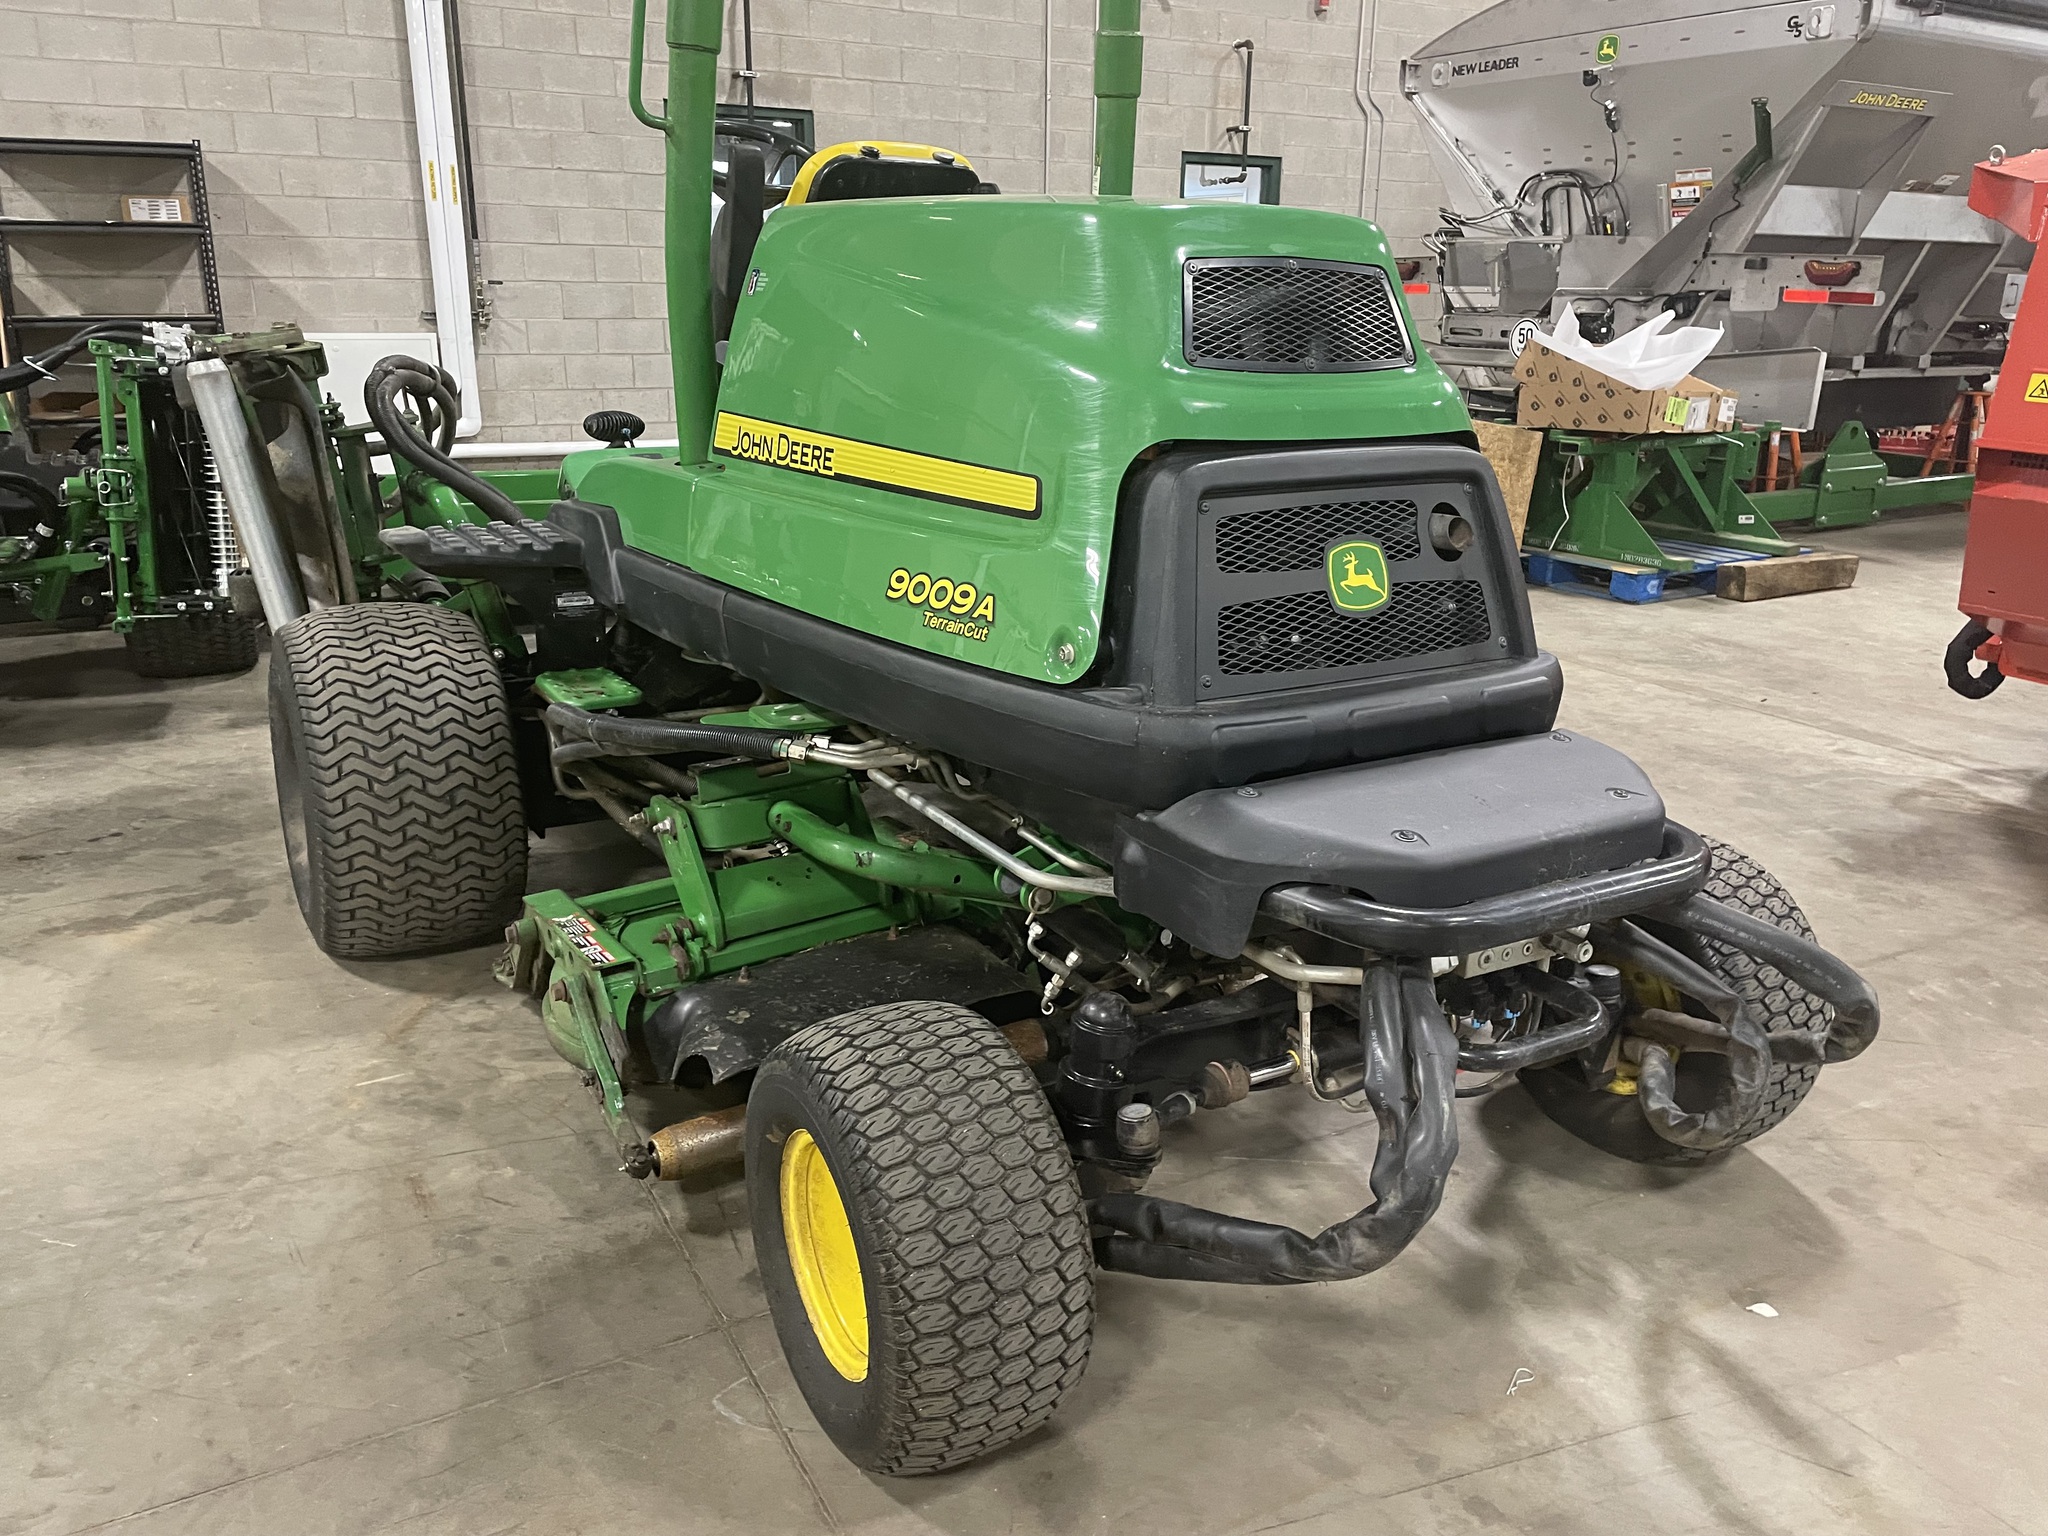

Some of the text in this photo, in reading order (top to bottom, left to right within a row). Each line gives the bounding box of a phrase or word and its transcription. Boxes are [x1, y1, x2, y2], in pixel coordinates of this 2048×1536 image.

[1451, 57, 1520, 77] NEW LEADER
[1849, 90, 1928, 112] JOHN DEERE
[731, 425, 834, 473] JOHN DEERE
[885, 567, 996, 624] 9009A
[922, 611, 989, 641] TerrainCut
